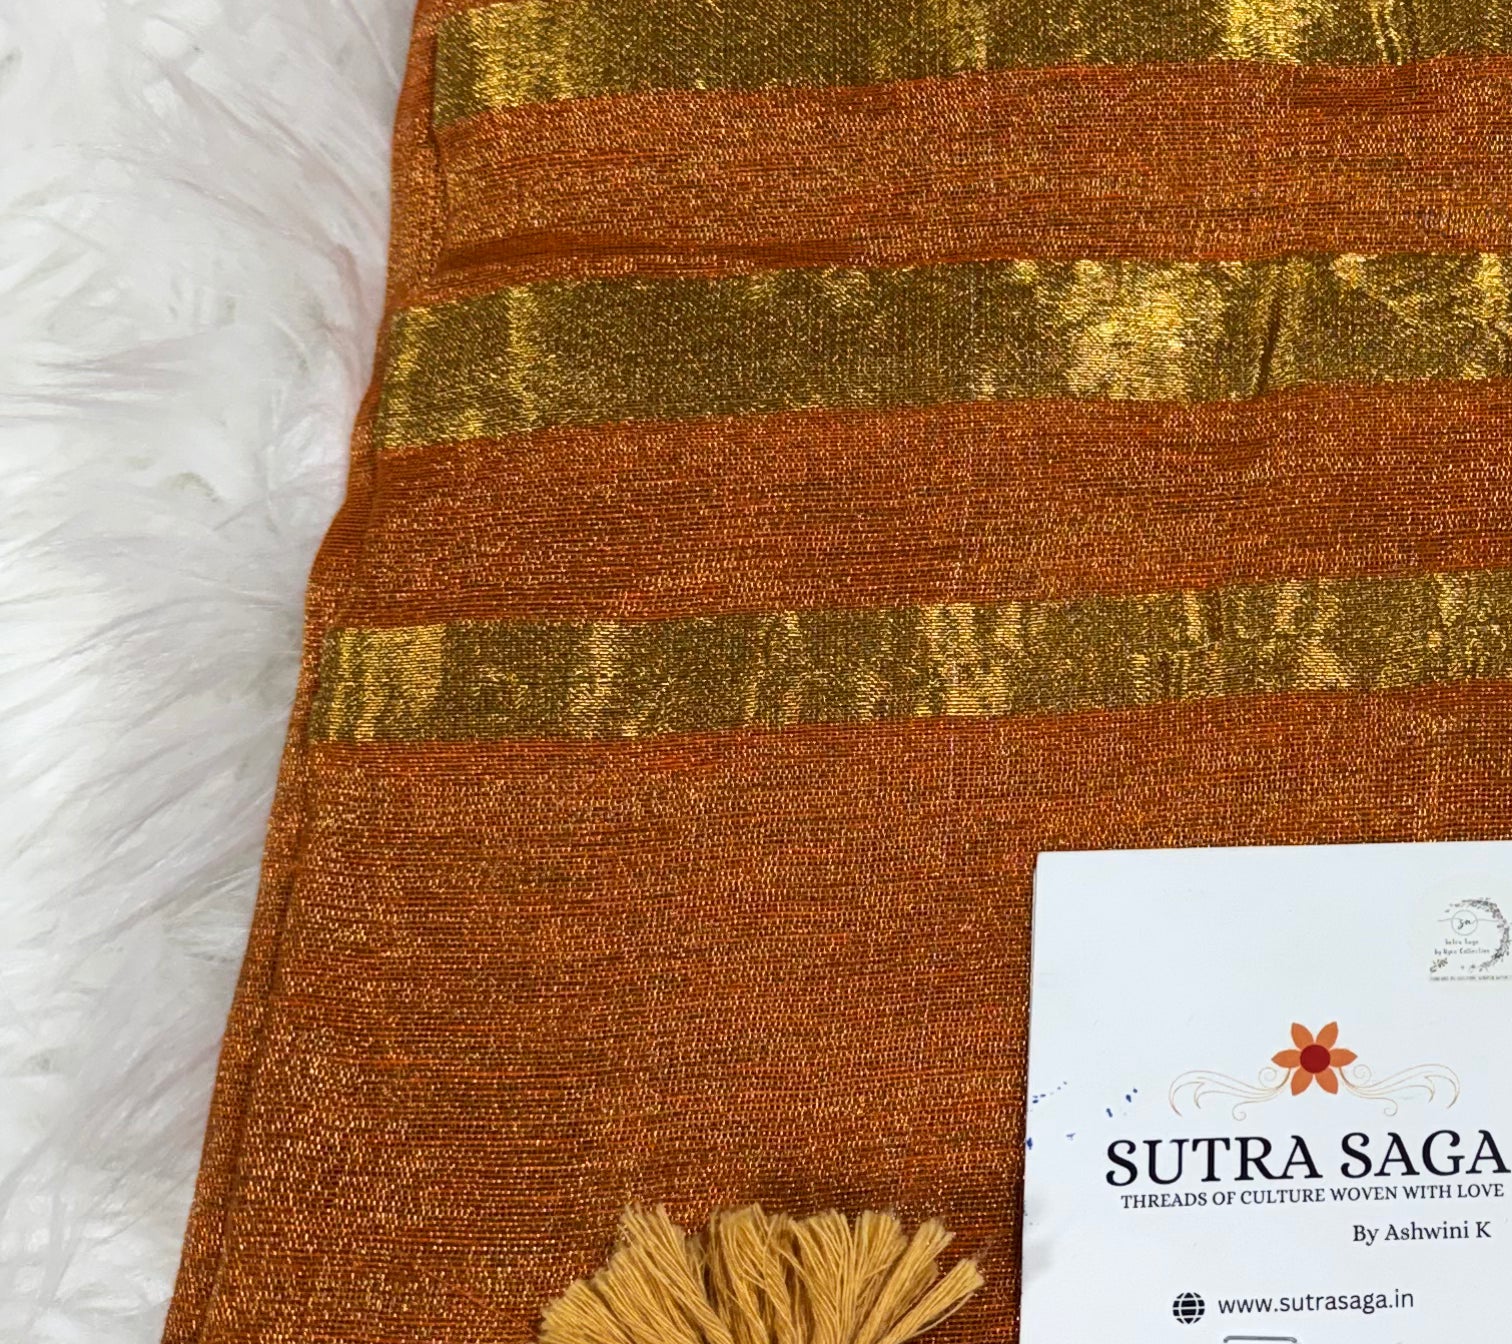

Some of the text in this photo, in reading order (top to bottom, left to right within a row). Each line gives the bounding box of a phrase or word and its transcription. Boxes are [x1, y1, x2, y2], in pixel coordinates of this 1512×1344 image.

[1105, 1129, 1512, 1187] SUTRA SAGA
[1120, 1183, 1505, 1210] THREADS OF CULTURE WOVEN WITH LOVE
[1352, 1219, 1493, 1247] By Ashwini K
[1217, 1288, 1416, 1316] www.sutrasaga.in
